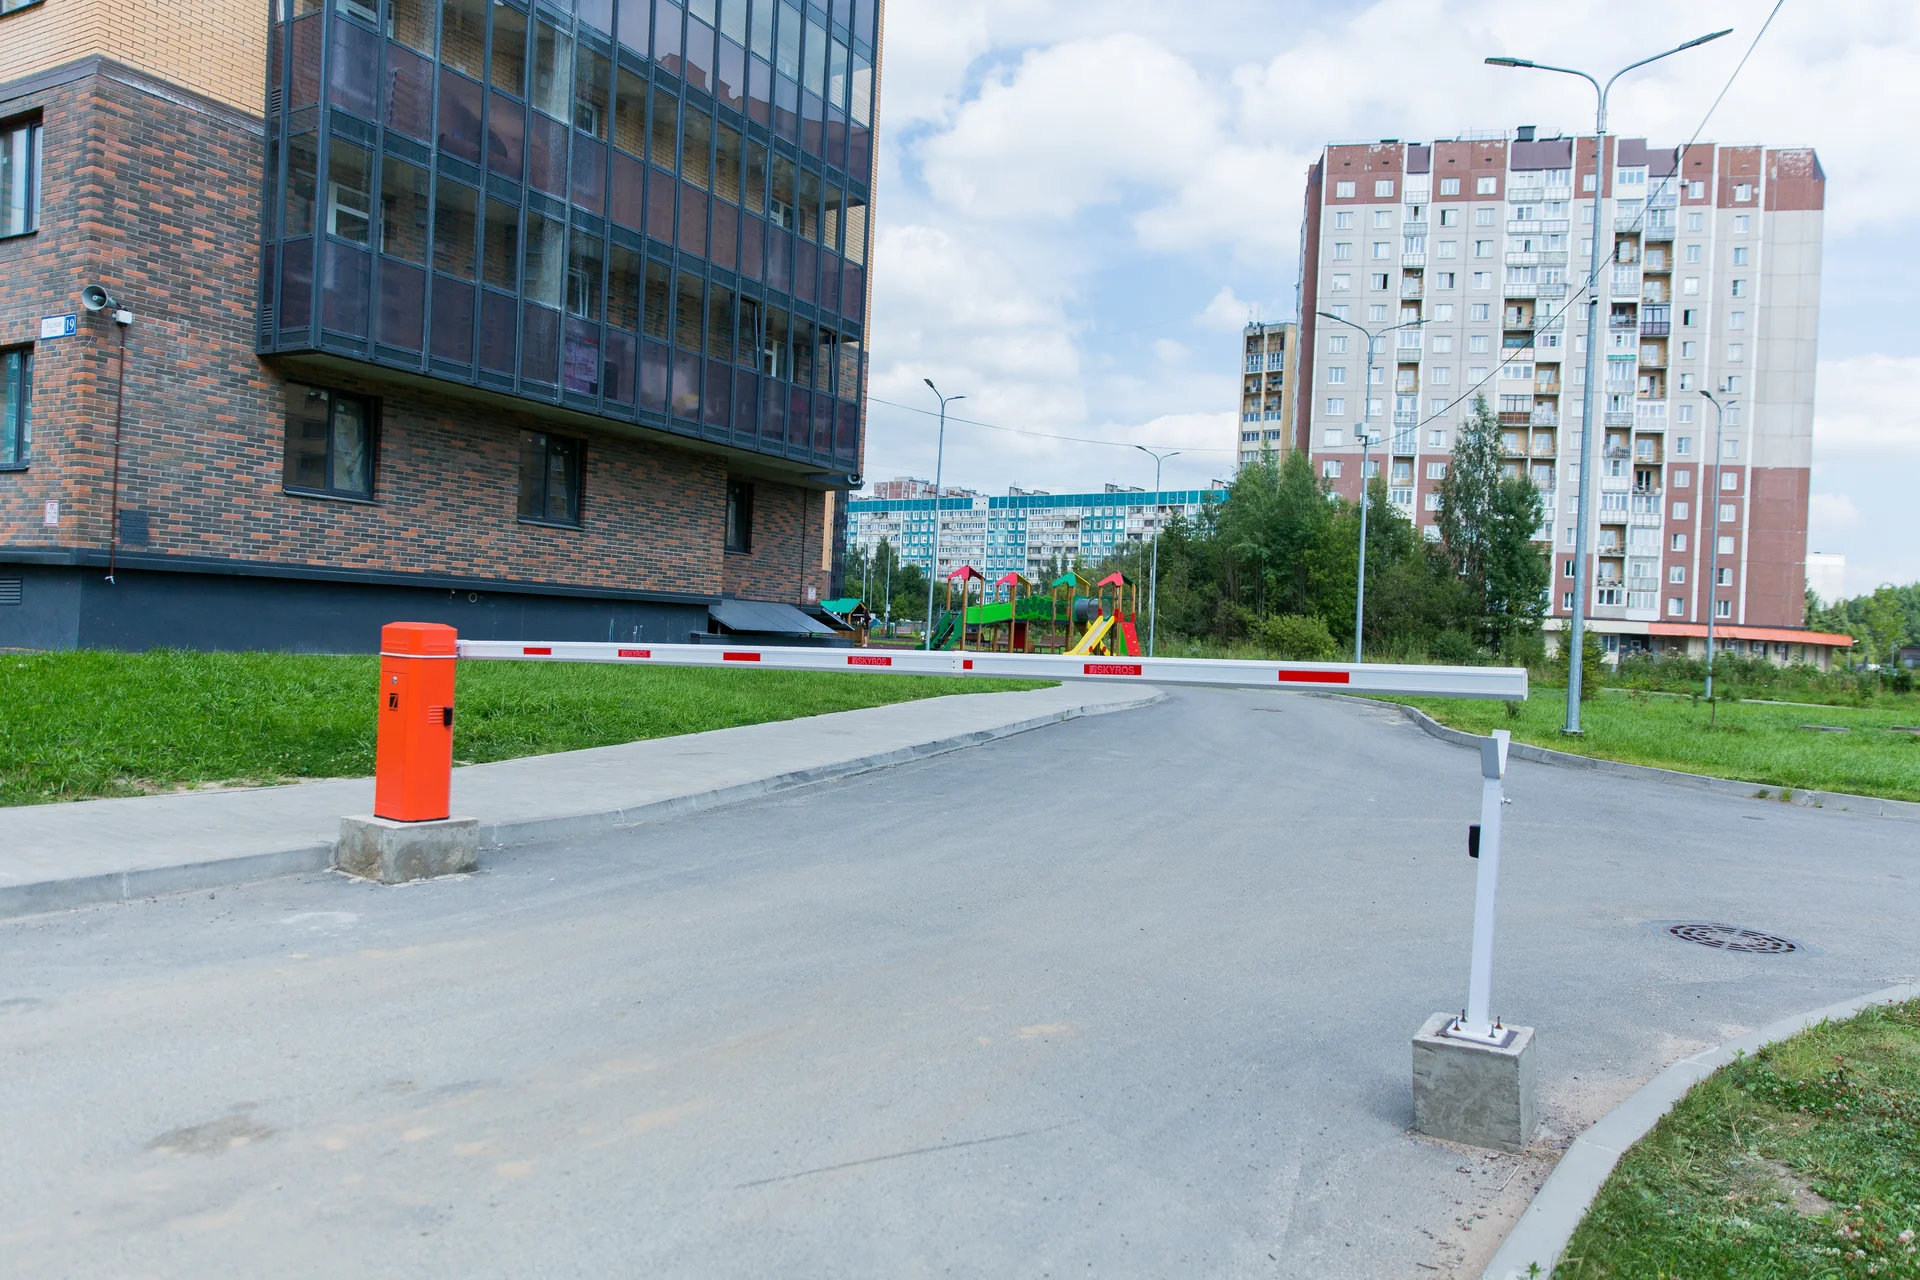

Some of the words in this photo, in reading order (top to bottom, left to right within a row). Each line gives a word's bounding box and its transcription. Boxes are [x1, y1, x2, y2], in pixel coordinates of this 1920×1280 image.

[66, 319, 75, 331] 19
[857, 657, 887, 665] SKYROS
[1097, 665, 1135, 674] SKYROS
